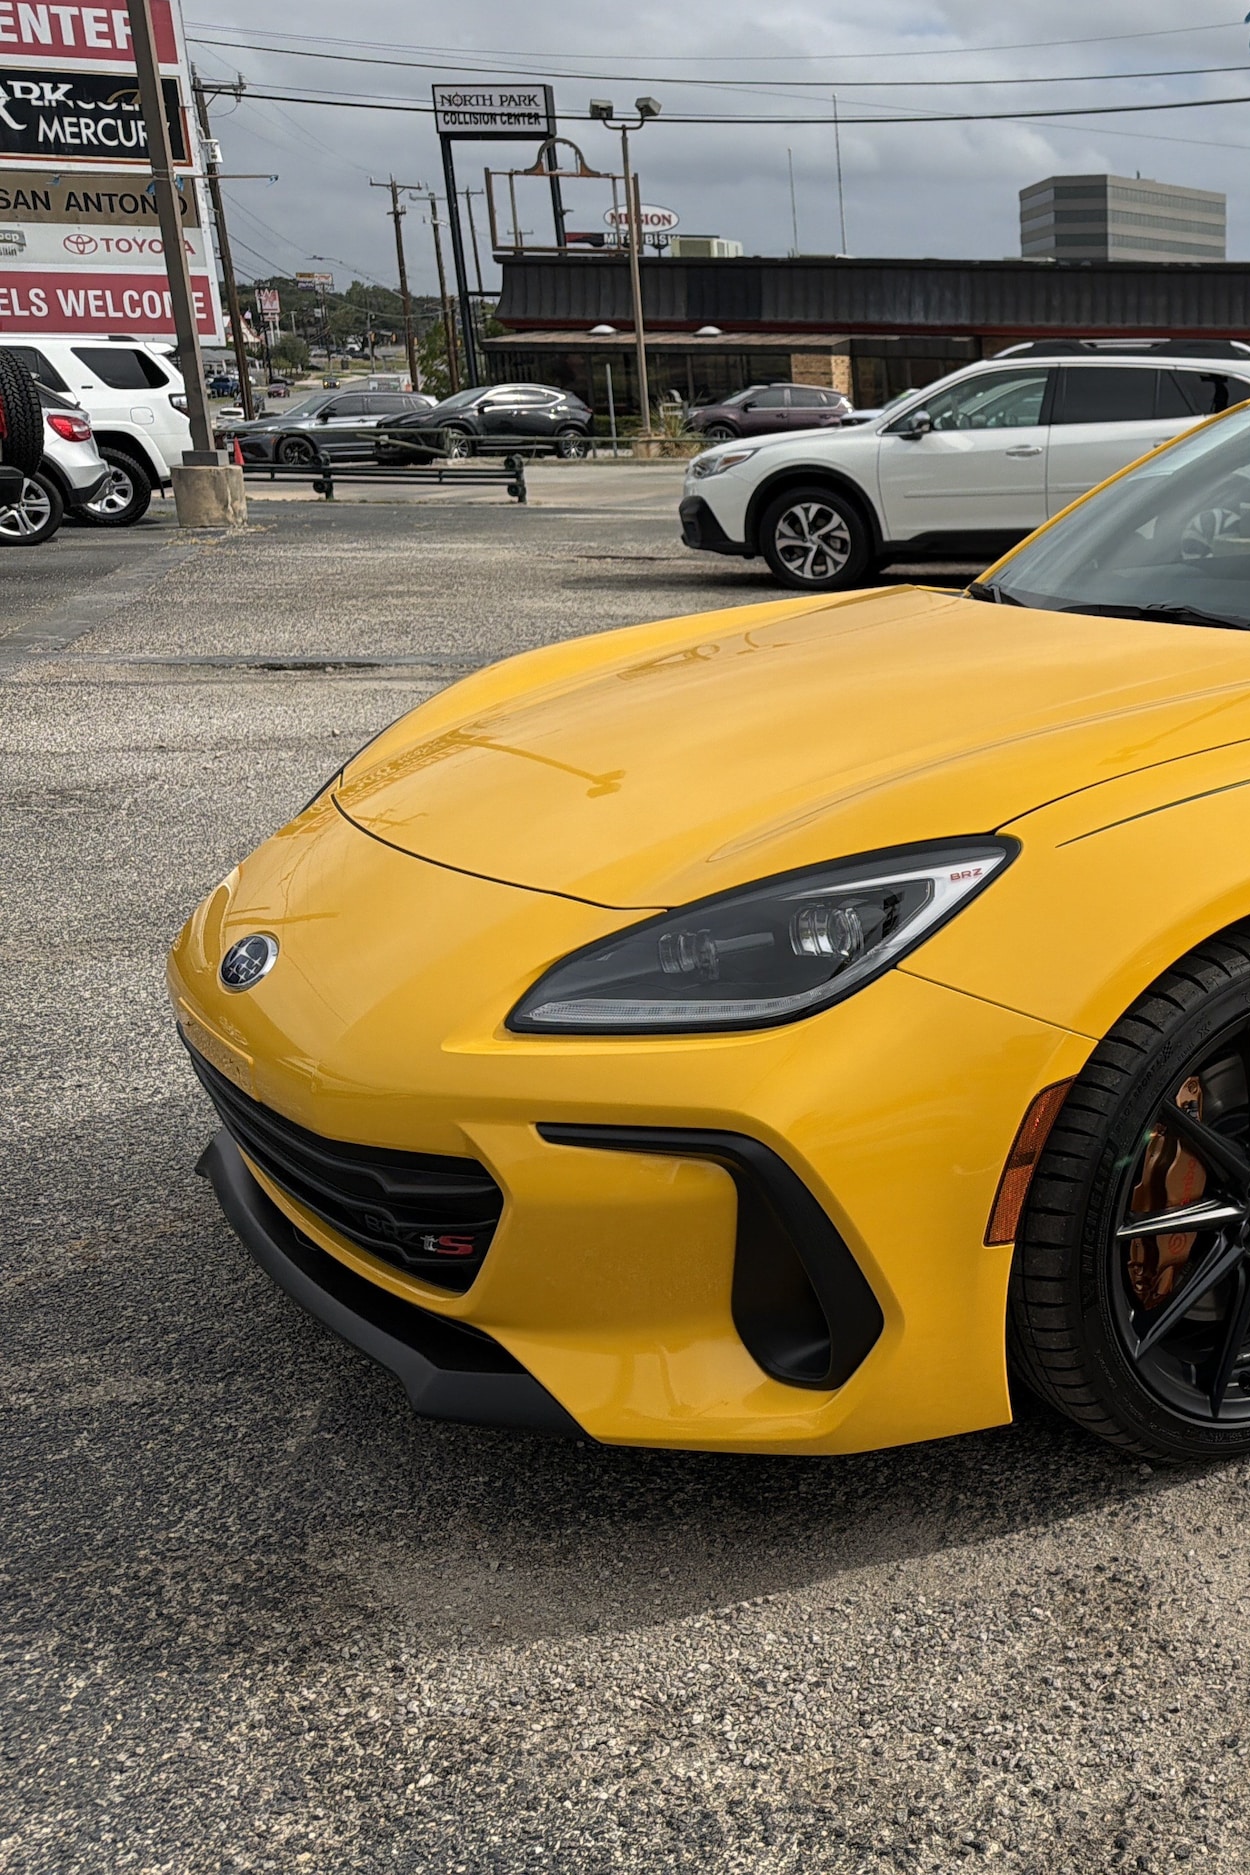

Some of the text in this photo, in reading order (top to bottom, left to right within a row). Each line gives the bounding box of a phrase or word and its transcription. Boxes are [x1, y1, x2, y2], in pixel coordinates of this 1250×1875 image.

[440, 92, 541, 107] NORTH PARK
[443, 111, 541, 126] COLLISION CENTER
[38, 115, 170, 148] MERCUR
[0, 189, 188, 216] SAN ANTON
[100, 238, 197, 255] TOYOA
[950, 867, 983, 881] BRZ
